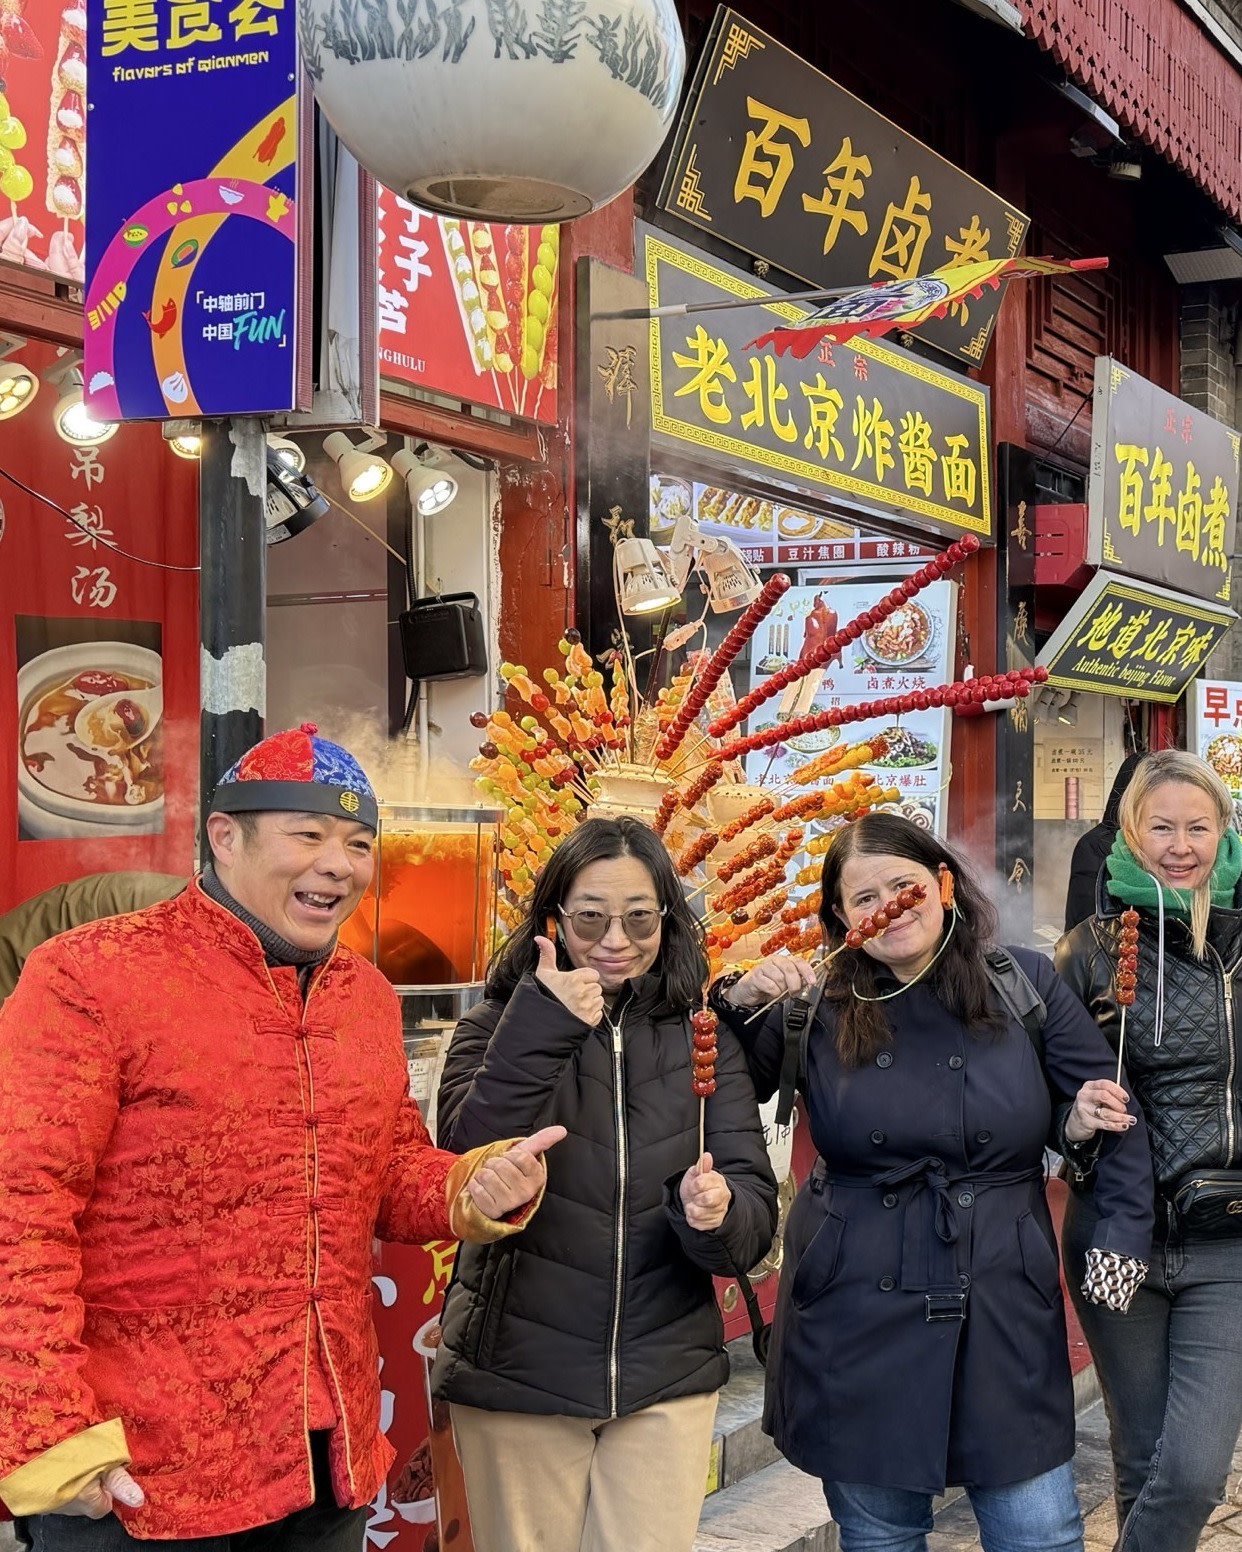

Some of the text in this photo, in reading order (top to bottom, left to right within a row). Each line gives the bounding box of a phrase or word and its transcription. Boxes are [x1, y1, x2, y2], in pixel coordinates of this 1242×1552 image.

[112, 63, 173, 82] flavors
[817, 341, 869, 382] 正宗
[672, 324, 978, 507] 老北京炸酱面
[1163, 408, 1194, 444] 正宗
[1114, 442, 1230, 573] 百年卤煮
[64, 447, 118, 608] 吊梨汤
[787, 544, 845, 561] 豆汁焦圈
[876, 542, 920, 558] 酸辣粉
[1076, 602, 1215, 672] 地道北京味
[867, 675, 927, 691] 卤煮火烧
[1071, 655, 1177, 688] Authentic beijing Flavor
